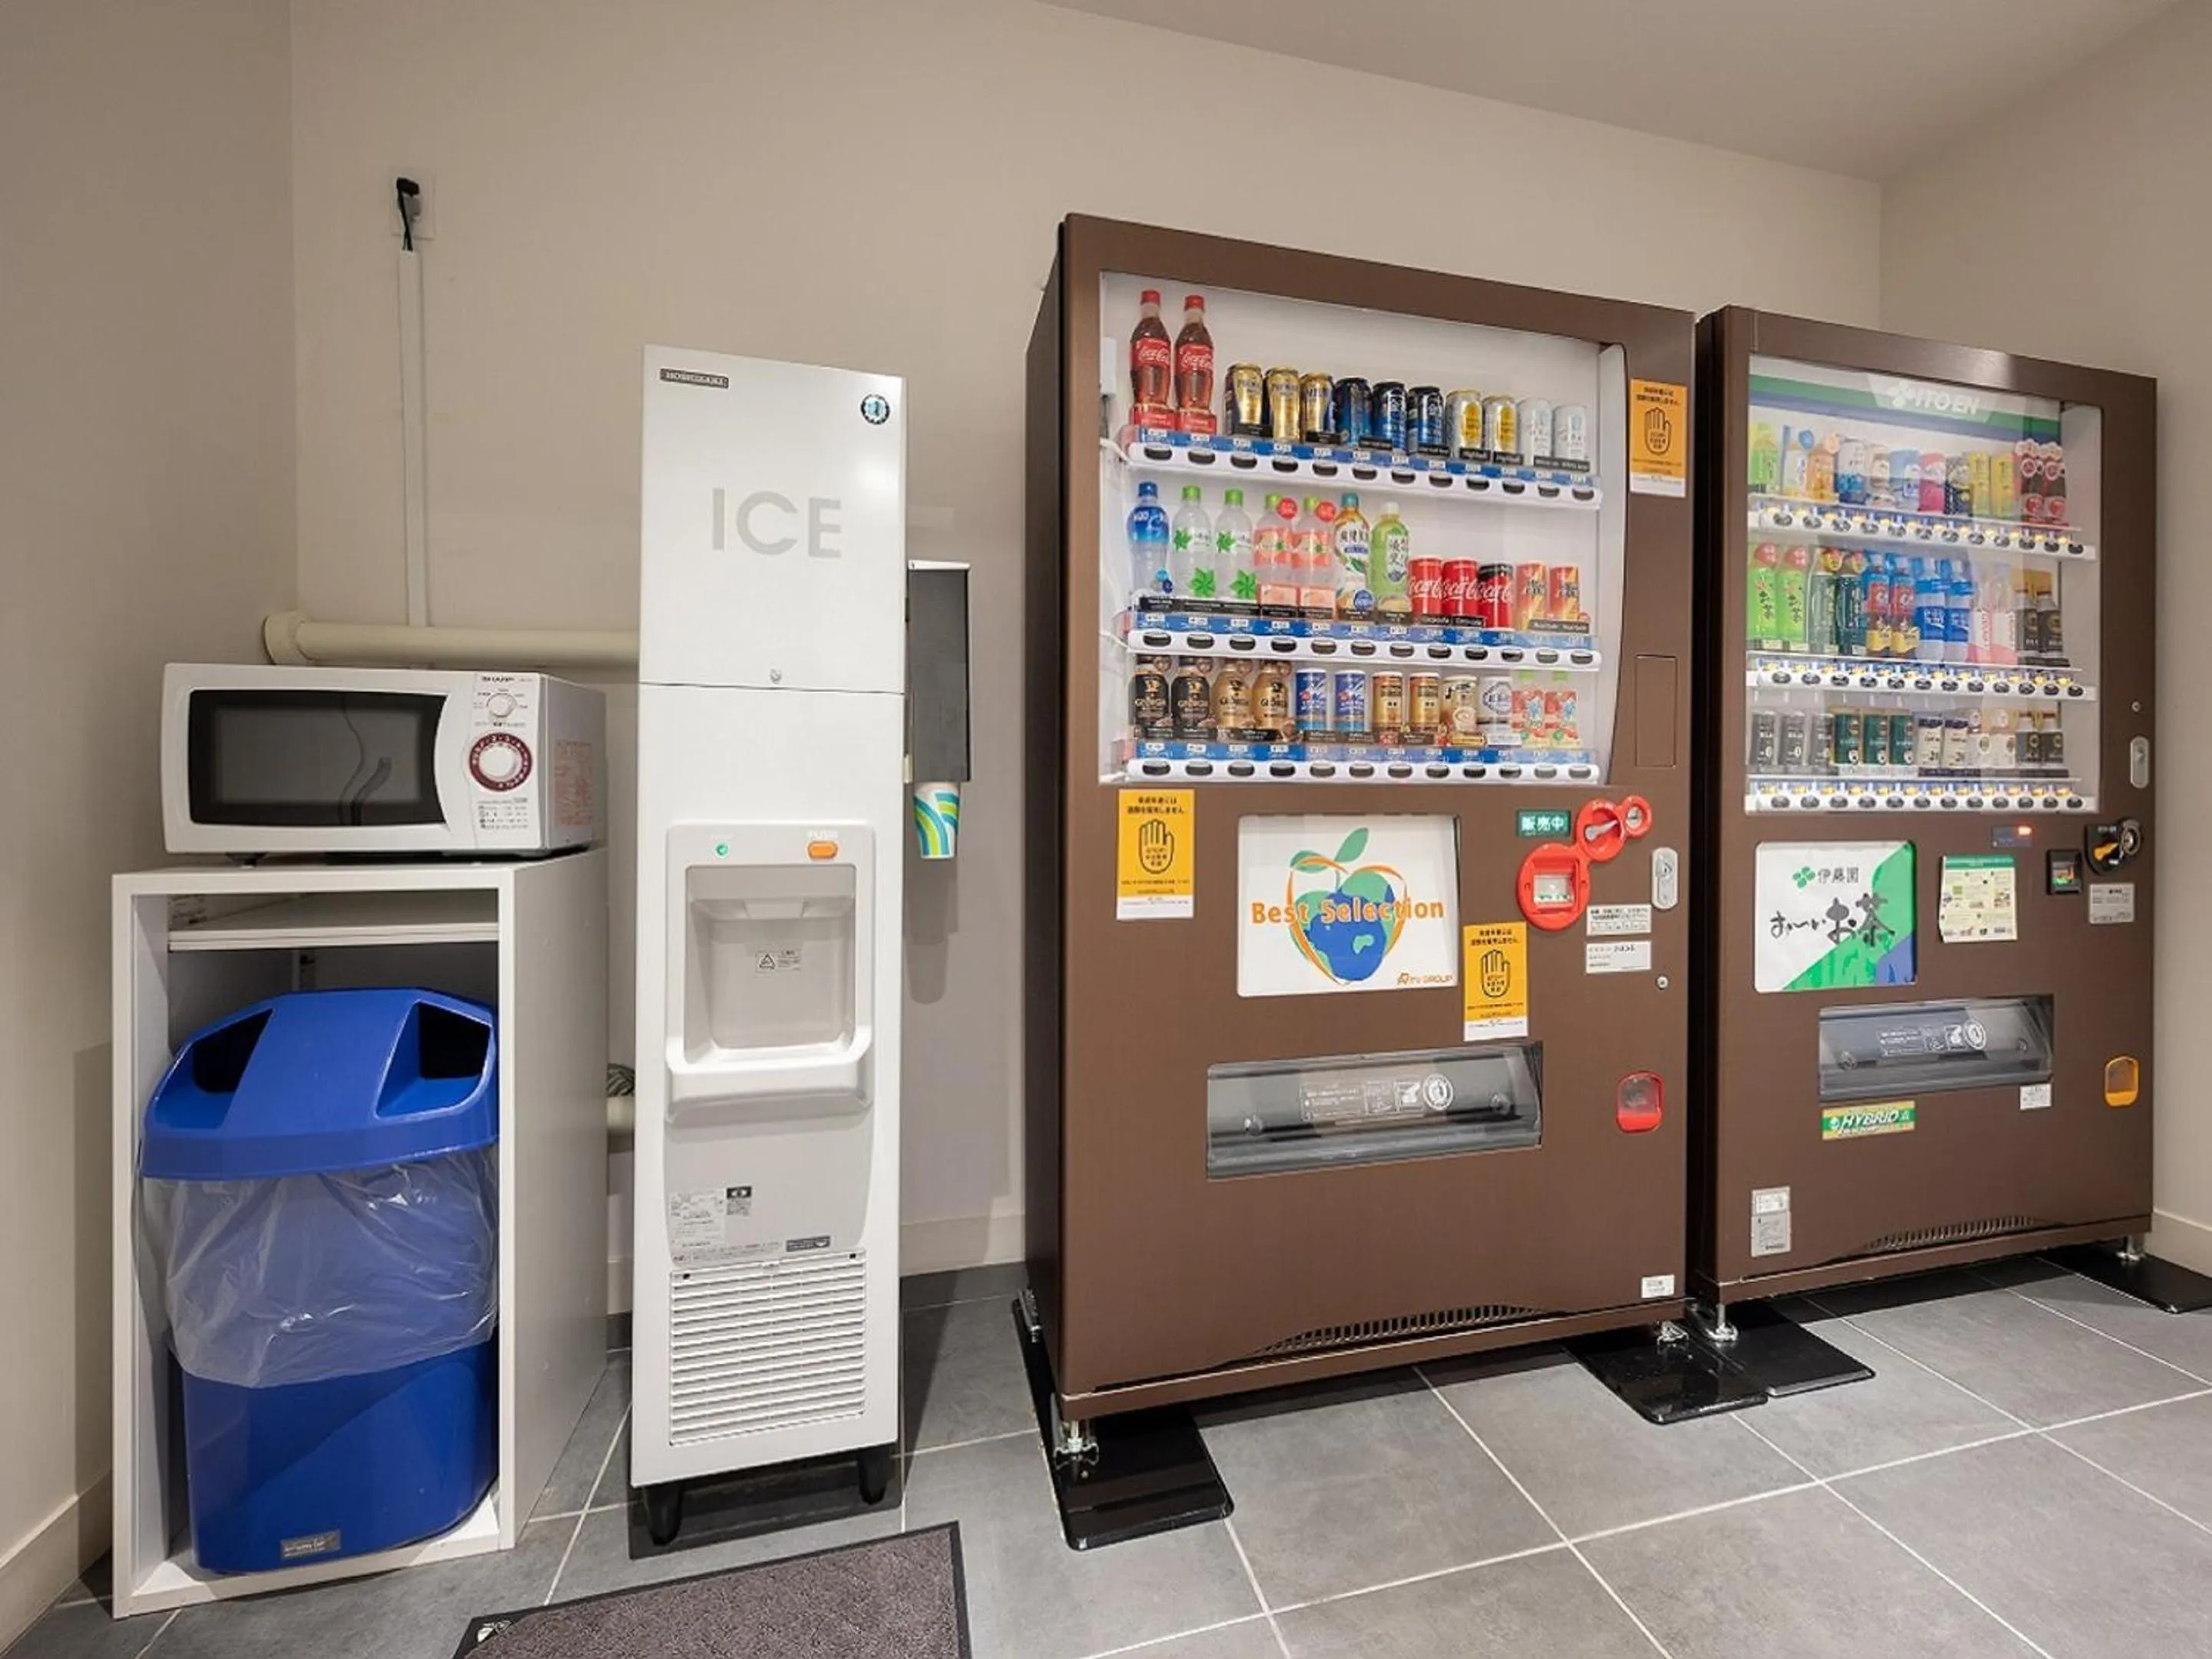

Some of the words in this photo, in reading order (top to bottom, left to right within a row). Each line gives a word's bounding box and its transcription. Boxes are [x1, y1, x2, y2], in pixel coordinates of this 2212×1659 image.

[712, 488, 842, 558] ICE
[1521, 815, 1565, 832] 販売中
[1817, 866, 1860, 884] 伊藤園
[1251, 901, 1310, 925] Best
[1320, 896, 1445, 924] Selection
